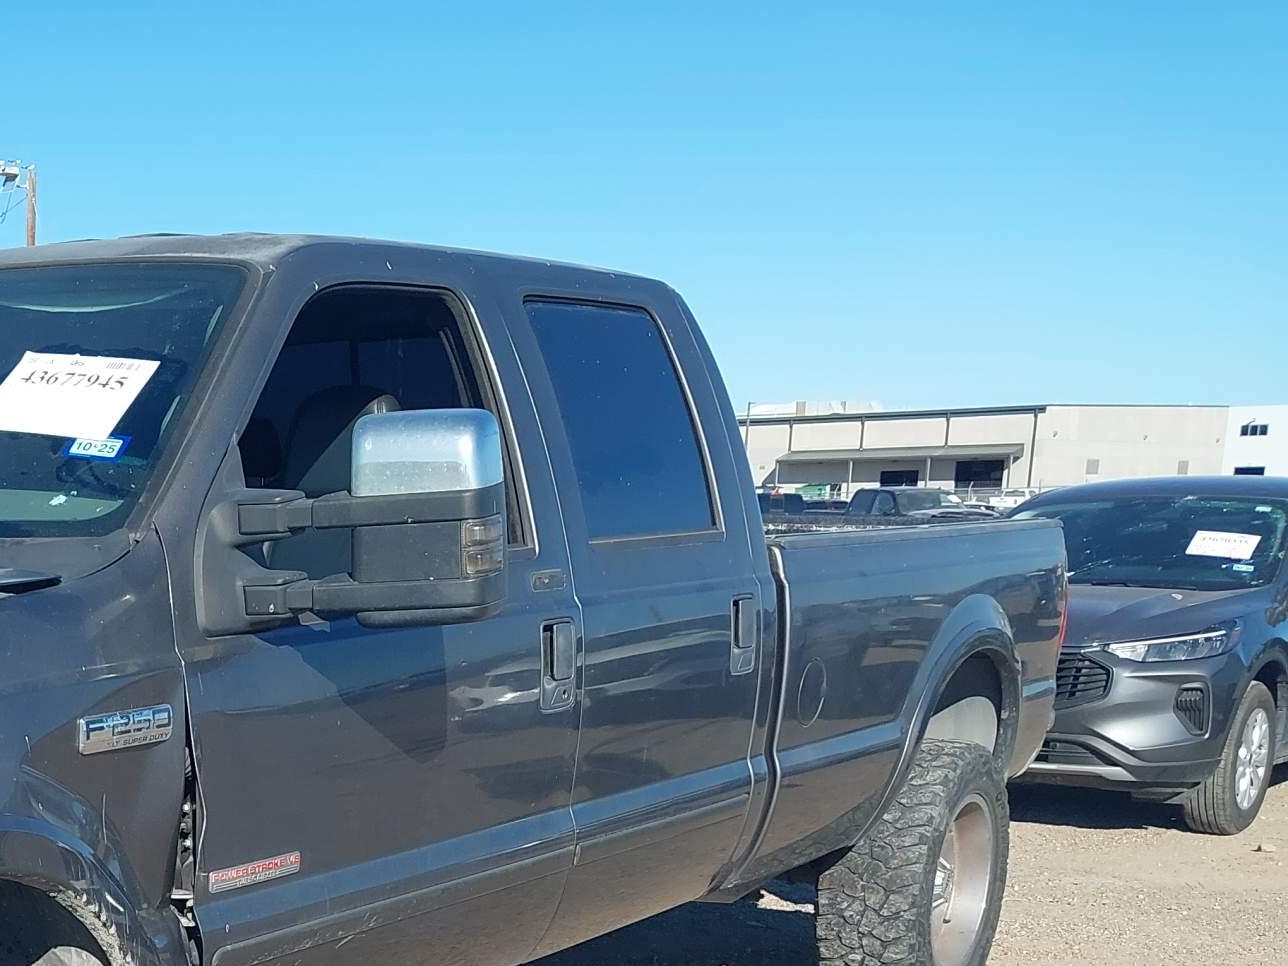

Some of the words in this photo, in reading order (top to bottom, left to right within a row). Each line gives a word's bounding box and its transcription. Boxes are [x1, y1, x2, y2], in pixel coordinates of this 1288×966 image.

[20, 370, 129, 391] 43677945
[122, 736, 148, 746] SUPER
[149, 731, 169, 741] DUTY
[248, 857, 286, 875] STROKE
